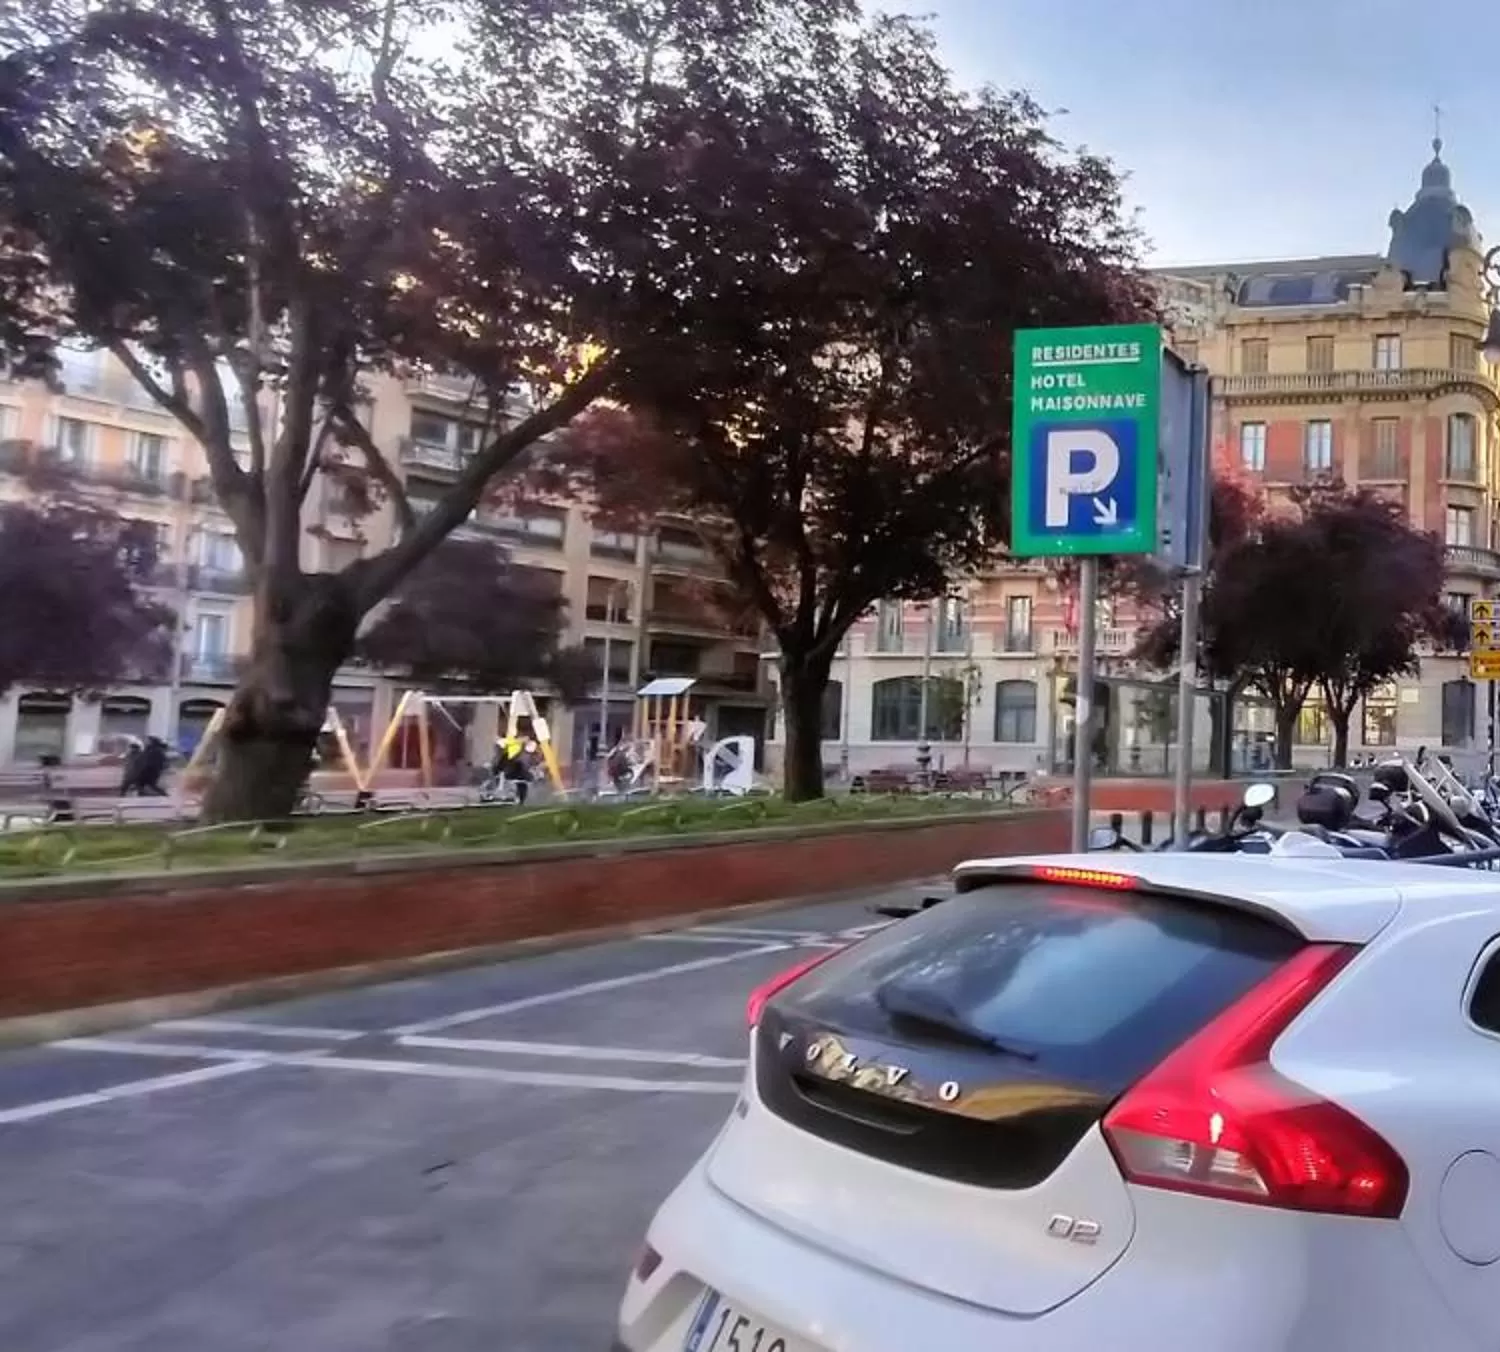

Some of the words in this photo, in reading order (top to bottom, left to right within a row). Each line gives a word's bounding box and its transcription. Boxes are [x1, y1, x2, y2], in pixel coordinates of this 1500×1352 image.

[1032, 342, 1140, 361] RESIDENTES
[1031, 372, 1086, 390] HOTEL
[1031, 393, 1147, 412] MAISONNAVE
[1045, 430, 1120, 527] P
[779, 1031, 960, 1101] VOLVO
